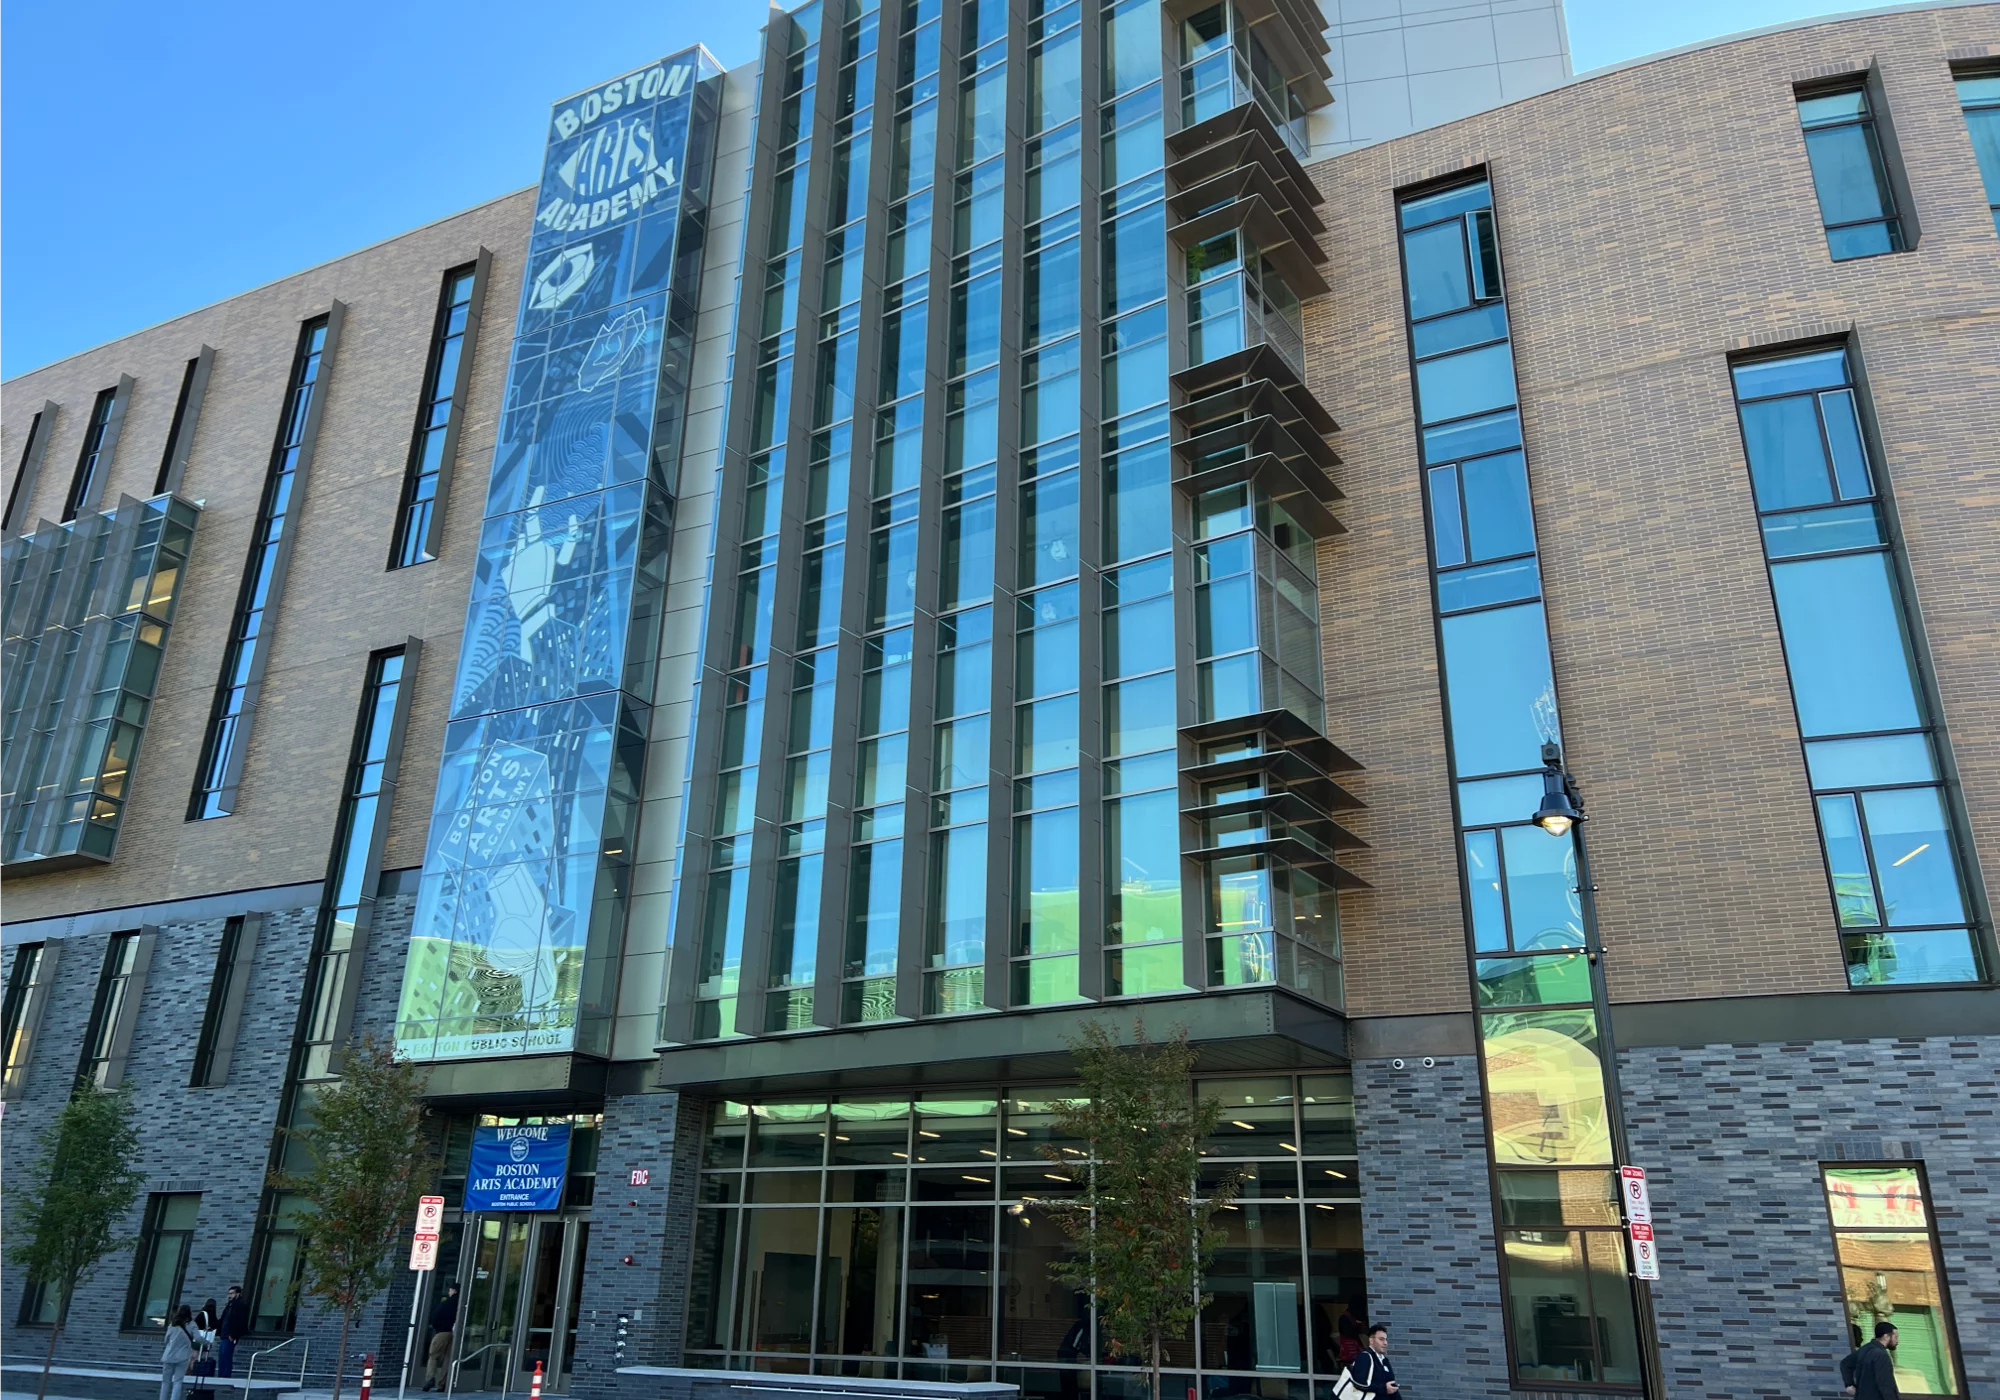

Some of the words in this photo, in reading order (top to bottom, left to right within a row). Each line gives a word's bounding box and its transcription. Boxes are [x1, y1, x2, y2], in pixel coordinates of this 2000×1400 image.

[554, 64, 692, 140] BOSTON
[568, 118, 659, 197] ARTS
[536, 157, 676, 232] ACADEMY
[450, 752, 503, 845] BOSTON
[468, 759, 521, 854] ARTS
[481, 767, 533, 860] ACADEMY
[463, 1038, 507, 1051] PUBLIC
[512, 1034, 562, 1048] SCHOOL
[497, 1127, 548, 1142] WELCOME
[472, 1178, 501, 1190] ARTS
[504, 1177, 559, 1190] ACADEMY
[496, 1163, 540, 1176] BOSTON
[631, 1169, 648, 1185] FDC
[500, 1193, 530, 1201] ENTRANCE
